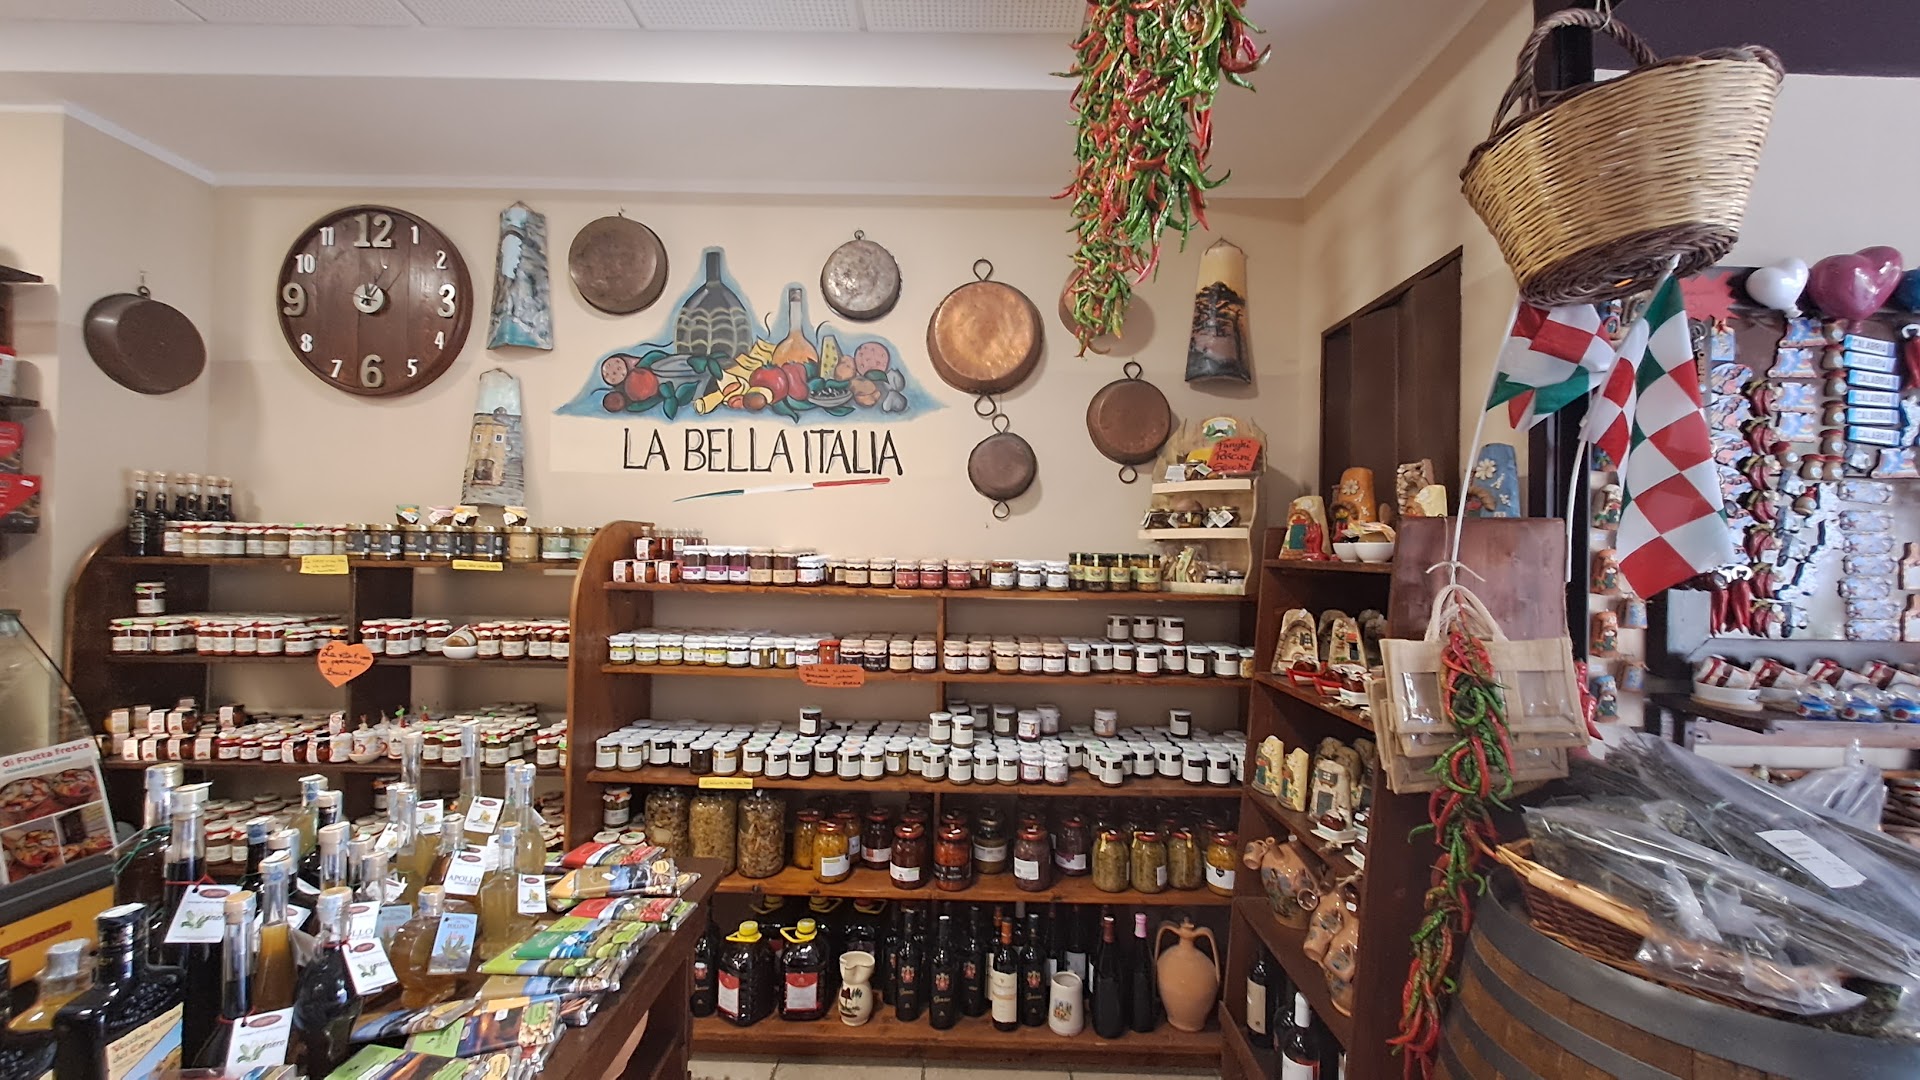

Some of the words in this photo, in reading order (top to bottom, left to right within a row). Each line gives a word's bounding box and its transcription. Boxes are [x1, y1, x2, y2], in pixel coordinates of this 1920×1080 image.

[319, 226, 335, 246] 11
[353, 214, 393, 248] 12
[411, 225, 420, 244] 1
[295, 254, 316, 273] 10
[436, 250, 447, 269] 2
[282, 283, 306, 317] 9
[437, 283, 456, 318] 3
[300, 333, 313, 352] 8
[434, 331, 445, 350] 4
[1853, 338, 1887, 352] CALABRIA
[331, 360, 343, 378] 7
[360, 354, 384, 388] 6
[407, 359, 418, 377] 5
[1857, 373, 1891, 386] CALABRIA
[1855, 392, 1890, 403] CALABRIA
[1856, 410, 1890, 420] CALABRIA
[1858, 428, 1891, 441] CALABRIA
[623, 427, 671, 472] LA
[683, 427, 794, 474] BELLA
[802, 428, 904, 476] ITALIA
[2, 758, 15, 767] di
[16, 750, 53, 764] Frutta
[448, 874, 481, 884] APOLLO
